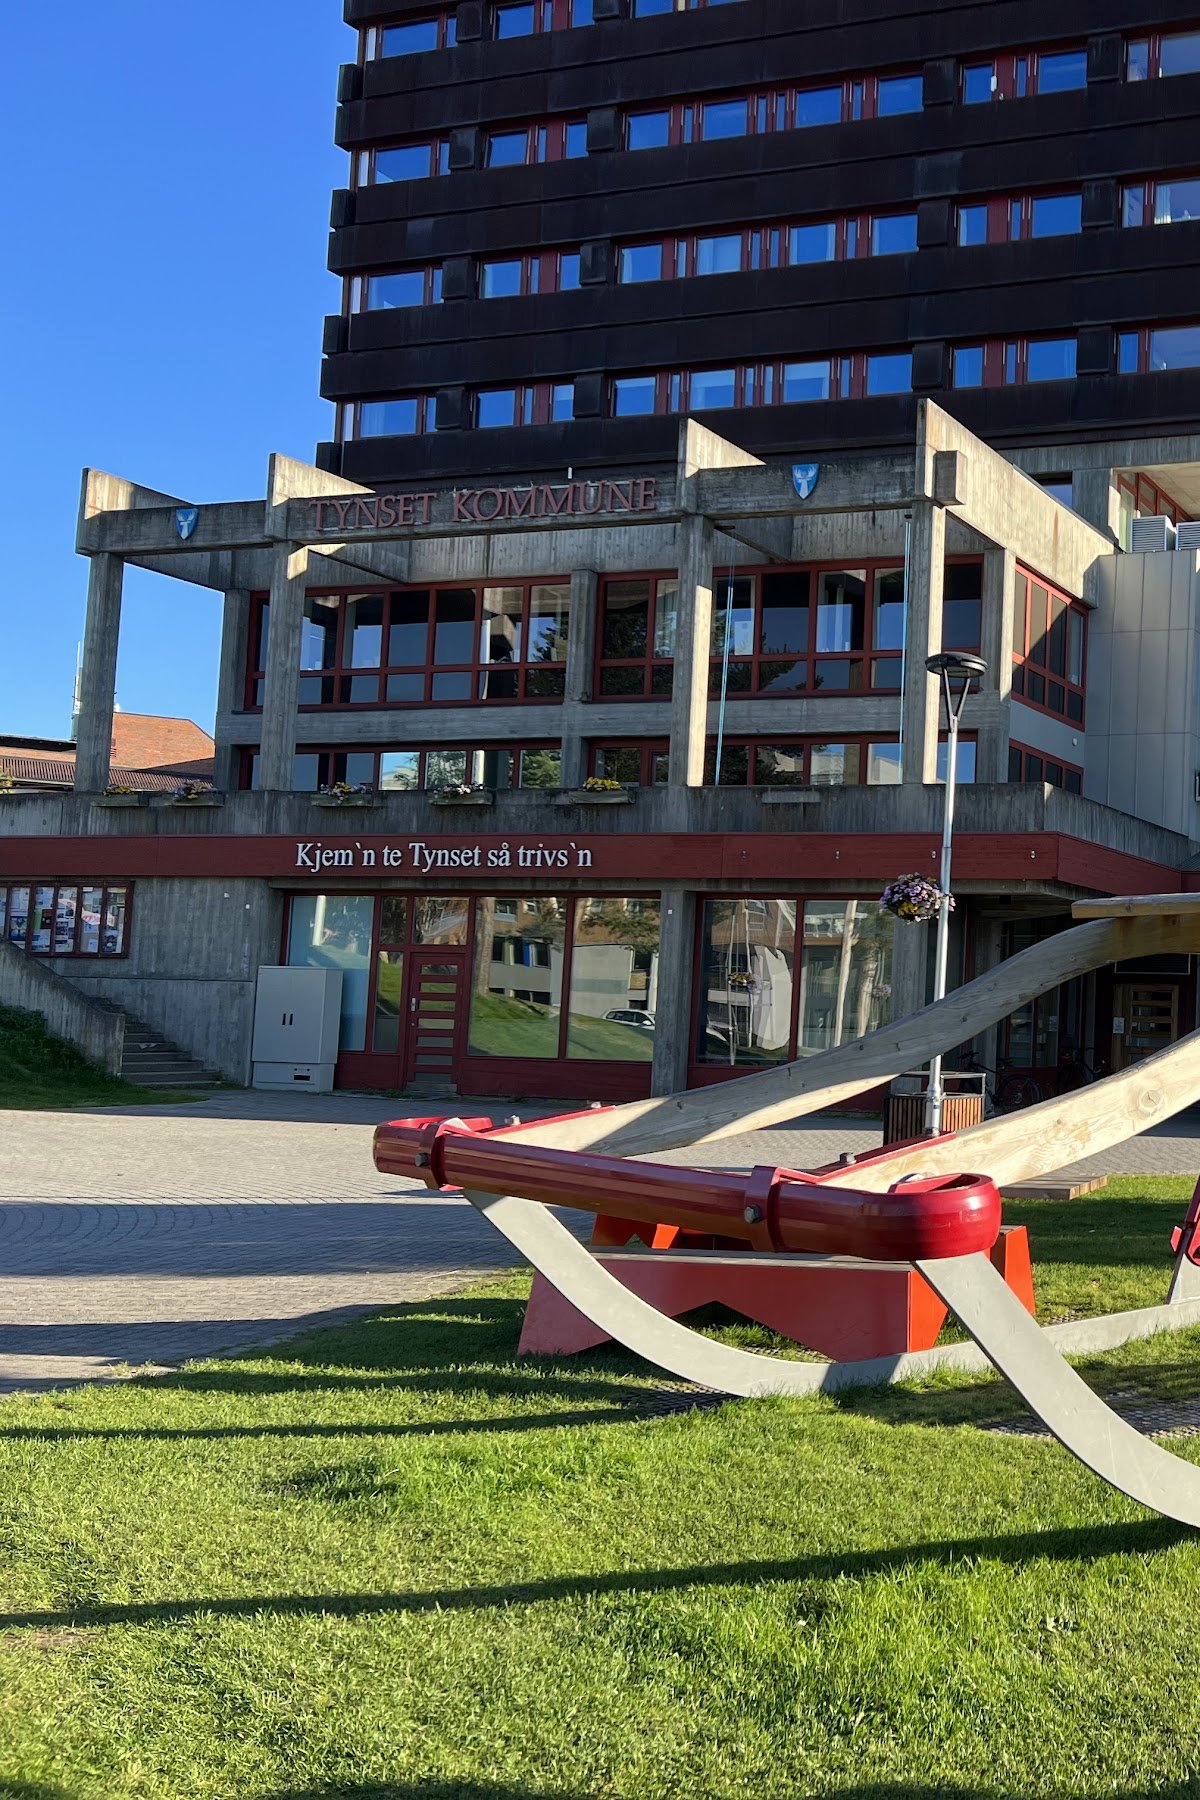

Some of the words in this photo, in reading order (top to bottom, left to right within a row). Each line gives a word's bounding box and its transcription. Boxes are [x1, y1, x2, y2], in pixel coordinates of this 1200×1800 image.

[309, 492, 438, 532] TYNSET
[451, 477, 657, 523] KOMMUNE
[382, 846, 402, 867] te
[408, 842, 482, 873] Tynset
[487, 842, 512, 868] så
